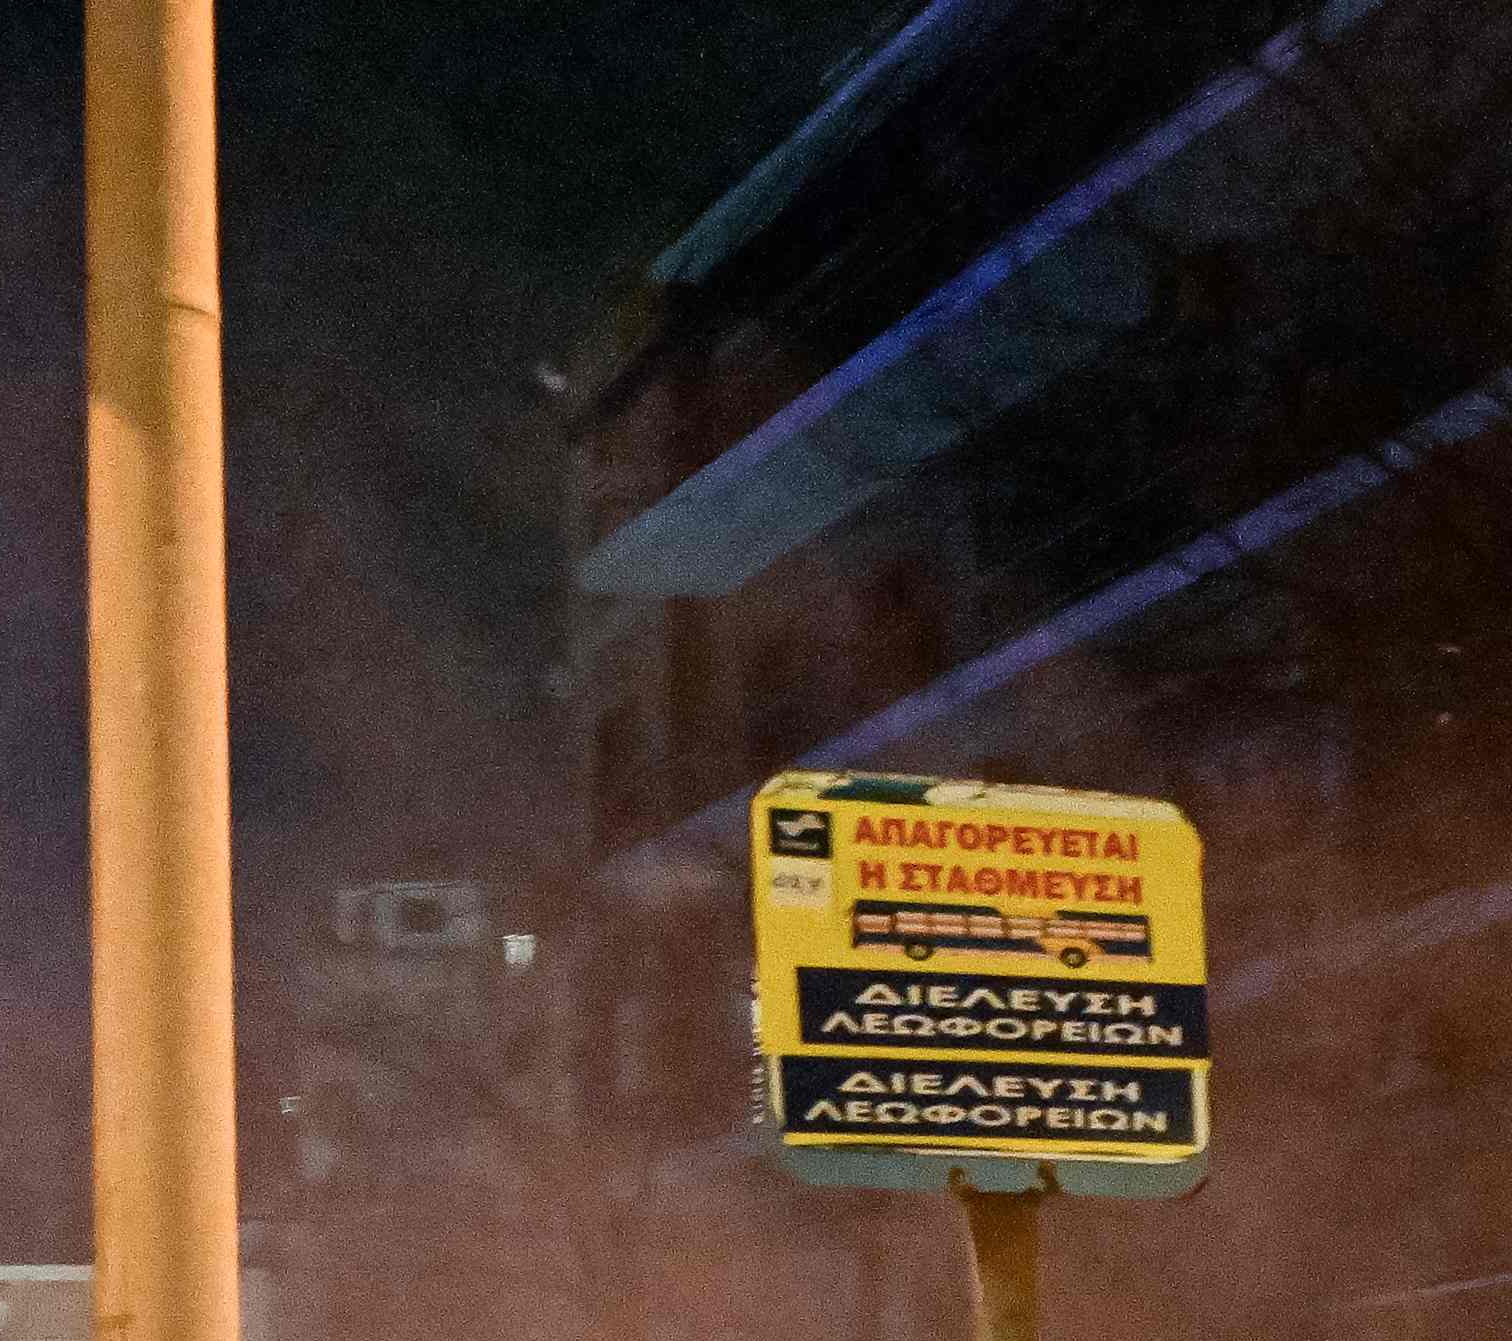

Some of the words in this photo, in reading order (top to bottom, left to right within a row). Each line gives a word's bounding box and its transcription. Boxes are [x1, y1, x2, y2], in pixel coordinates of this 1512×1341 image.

[854, 815, 1139, 861] ΑΠΑΓΟΡΕΥΕΤΑΙ
[859, 860, 887, 890] Η
[900, 862, 1143, 905] ΣΤΑΘΜΕΥΣΗ
[855, 983, 1157, 1017] ΔΙΕΛΕΥΣΗ
[821, 1011, 1184, 1047] ΛΕΩΦΟΡΕΙΩΝ
[837, 1071, 1142, 1103] ΔΙΕΛΕΥΣΗ
[803, 1100, 1169, 1133] ΛΕΩΦΟΡΕΙΩΝ
